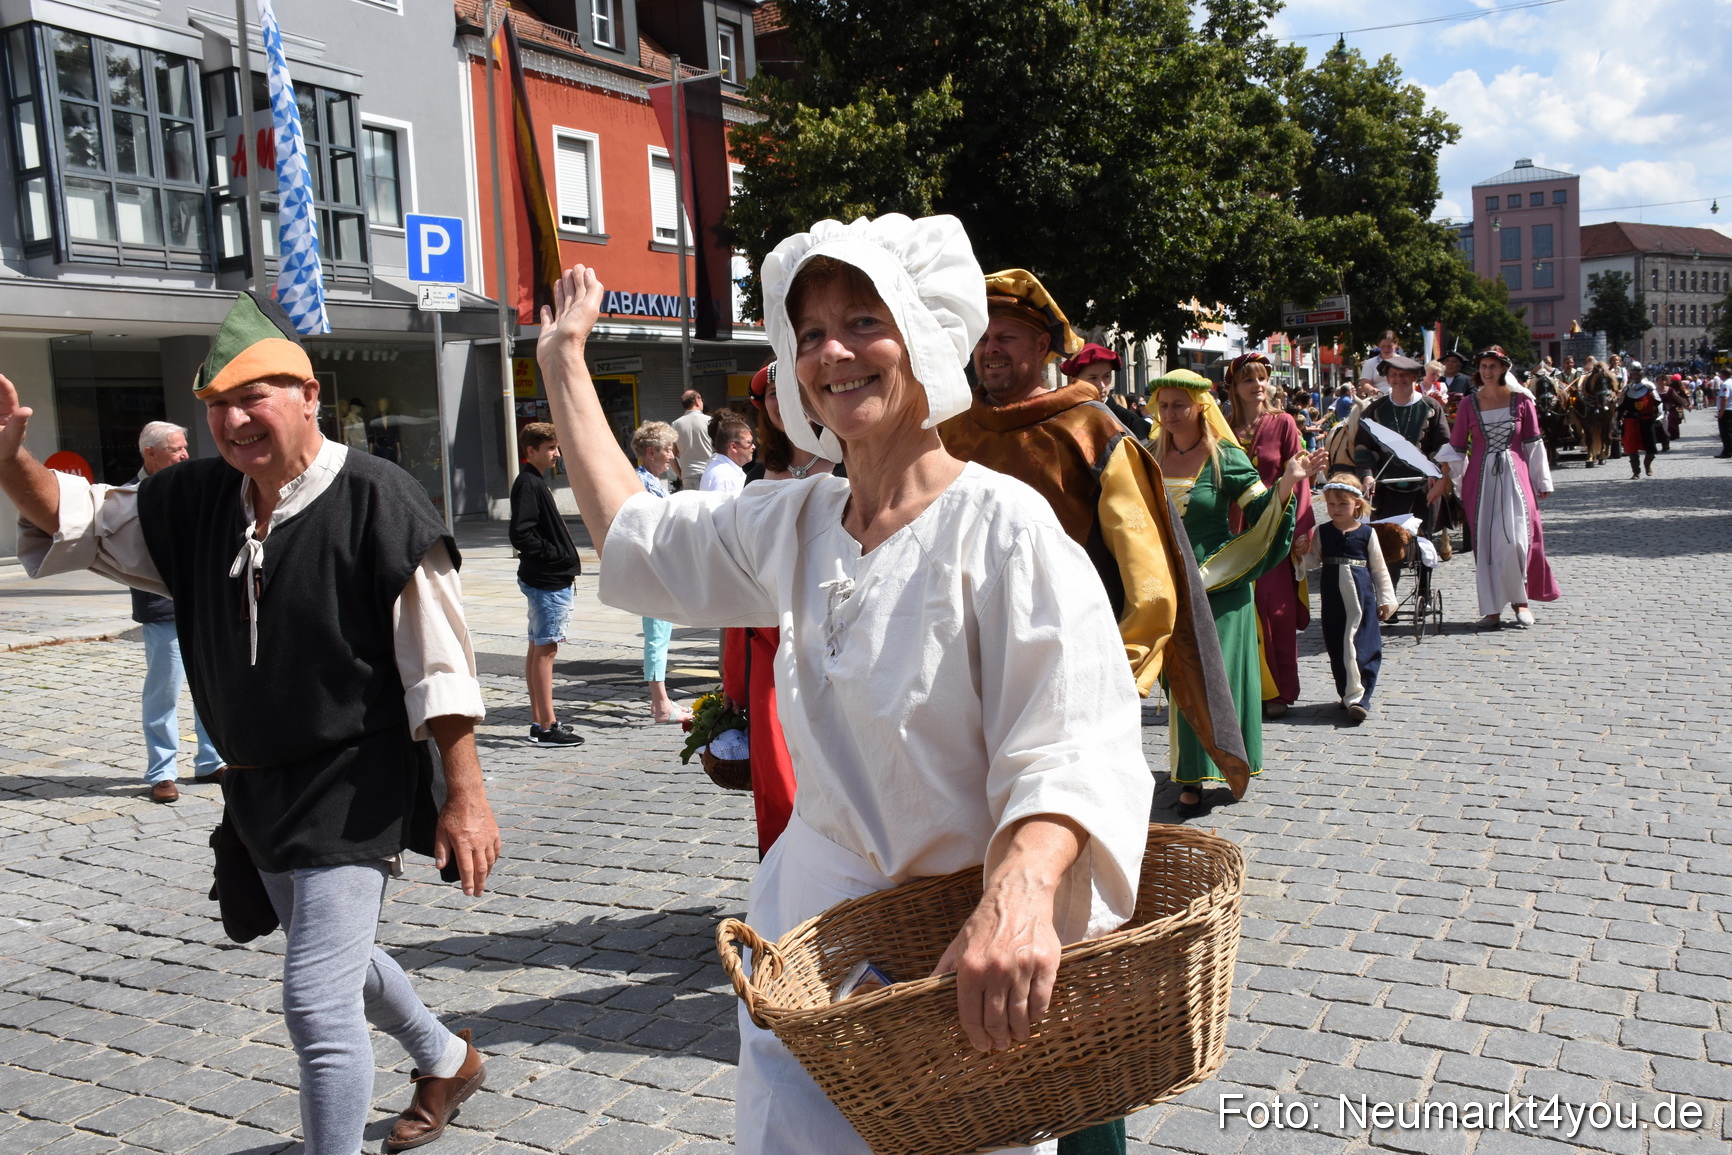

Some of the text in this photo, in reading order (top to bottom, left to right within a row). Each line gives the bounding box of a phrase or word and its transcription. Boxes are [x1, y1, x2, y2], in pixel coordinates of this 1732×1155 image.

[231, 126, 275, 178] HM
[420, 224, 450, 273] P
[600, 290, 696, 319] ABAKW
[596, 362, 612, 372] NZ
[514, 379, 533, 388] OTTO
